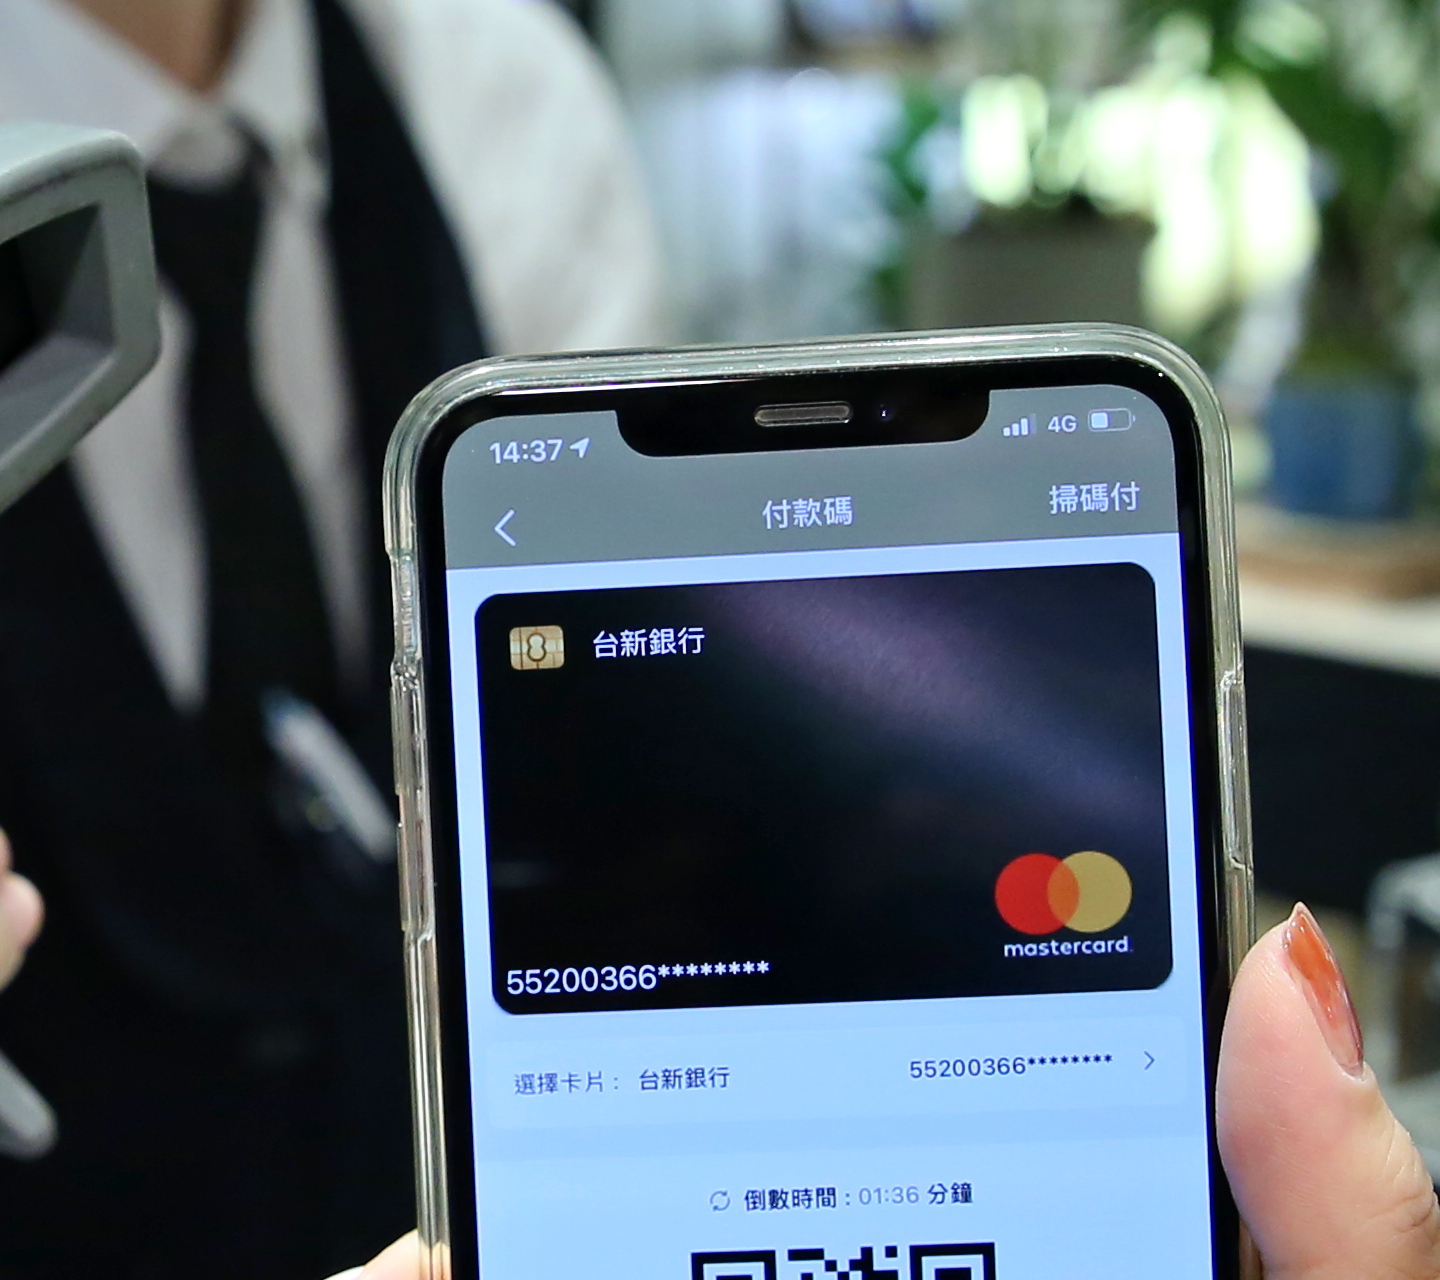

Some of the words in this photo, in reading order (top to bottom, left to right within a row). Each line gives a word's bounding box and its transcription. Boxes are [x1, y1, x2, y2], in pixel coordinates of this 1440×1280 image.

[1048, 414, 1077, 433] 4G
[490, 440, 562, 464] 14:37
[1048, 482, 1141, 515] 掃碼付
[762, 496, 854, 530] 付款碼
[592, 626, 706, 659] 台新銀行
[1004, 935, 1129, 957] mastercard
[639, 1066, 731, 1091] 台新銀行
[858, 1185, 920, 1207] 01:36
[927, 1182, 974, 1206] 分鐘
